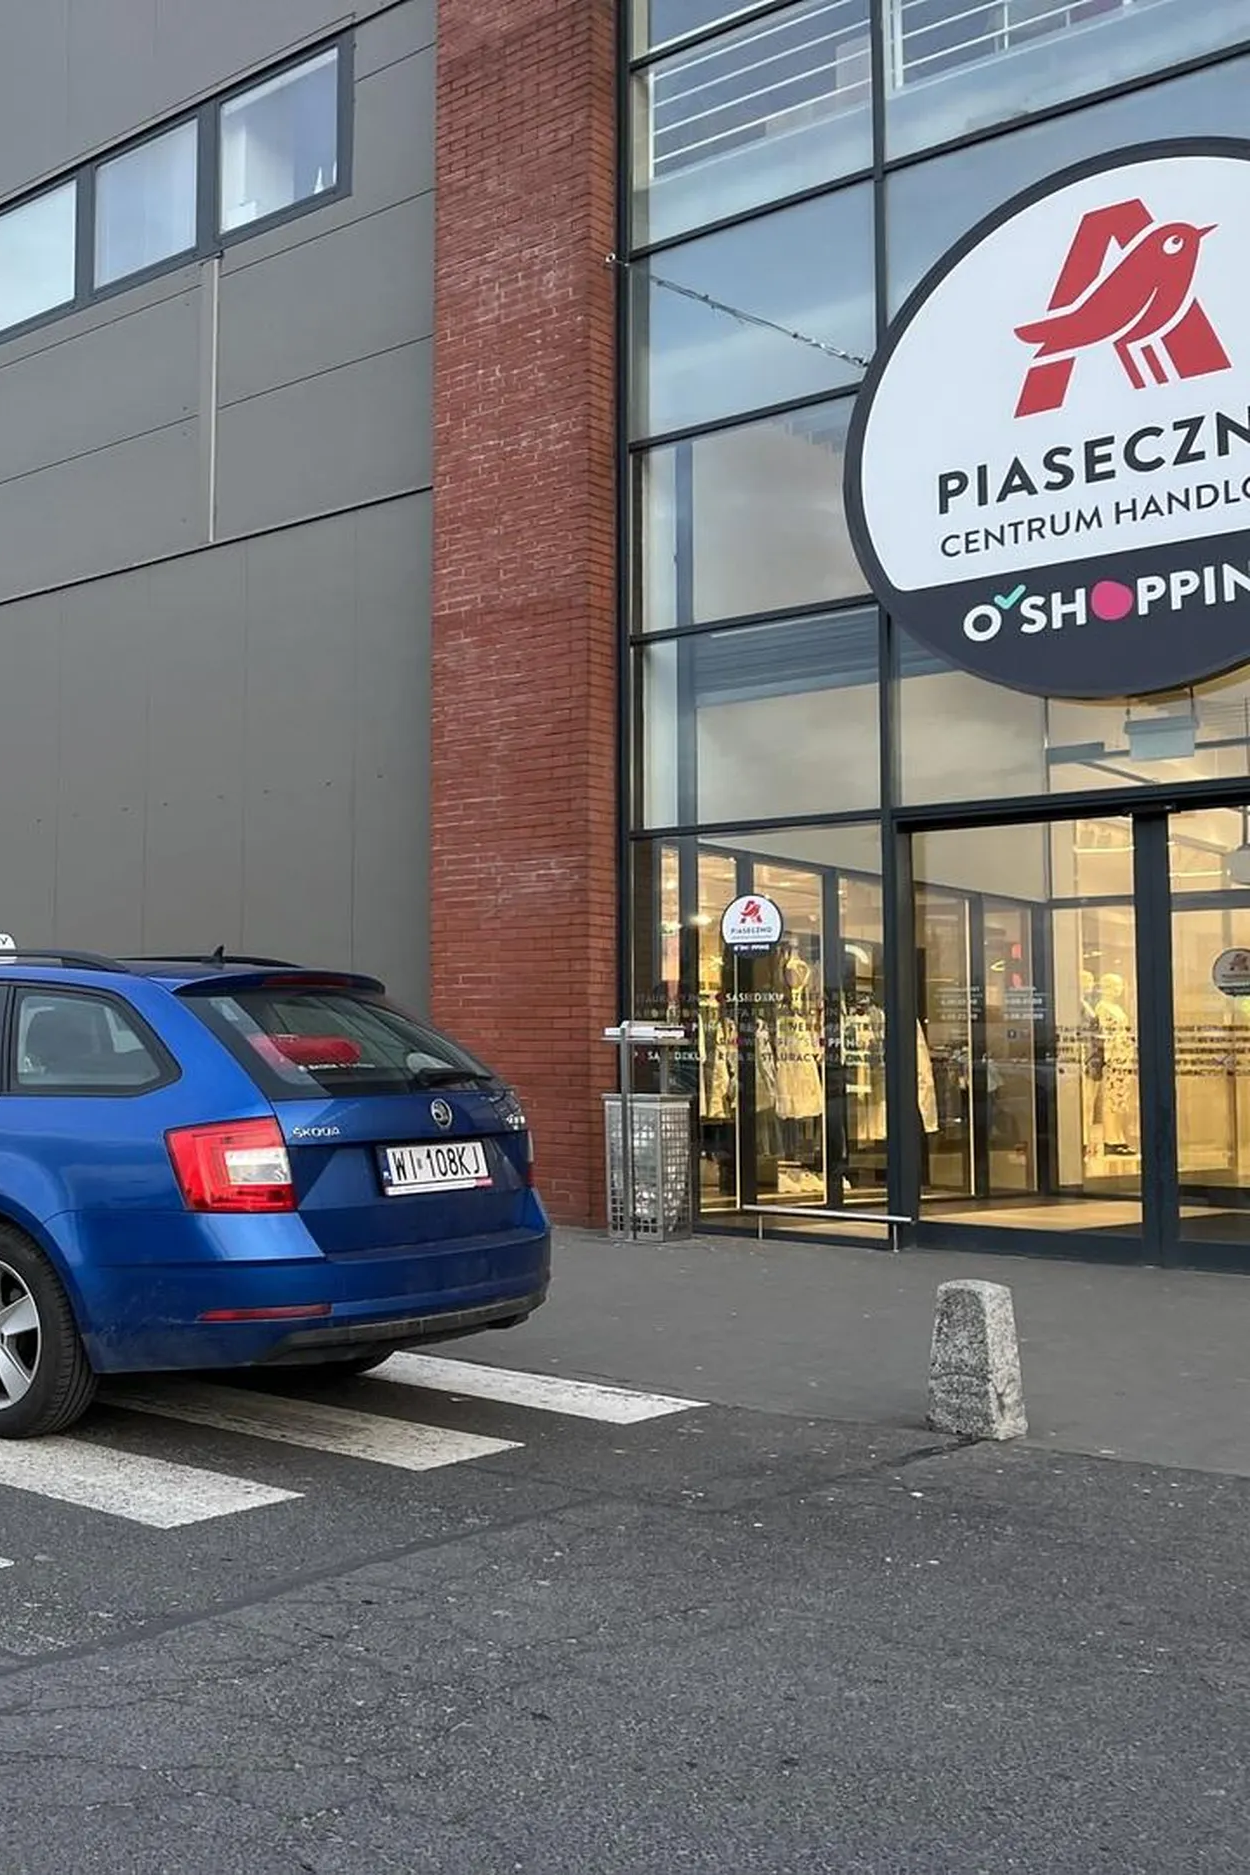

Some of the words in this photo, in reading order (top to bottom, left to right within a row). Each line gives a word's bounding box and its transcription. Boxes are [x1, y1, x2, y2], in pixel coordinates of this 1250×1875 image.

[940, 506, 1103, 558] CENTRUM
[392, 1149, 417, 1181] WI
[426, 1146, 480, 1178] 108KJ
